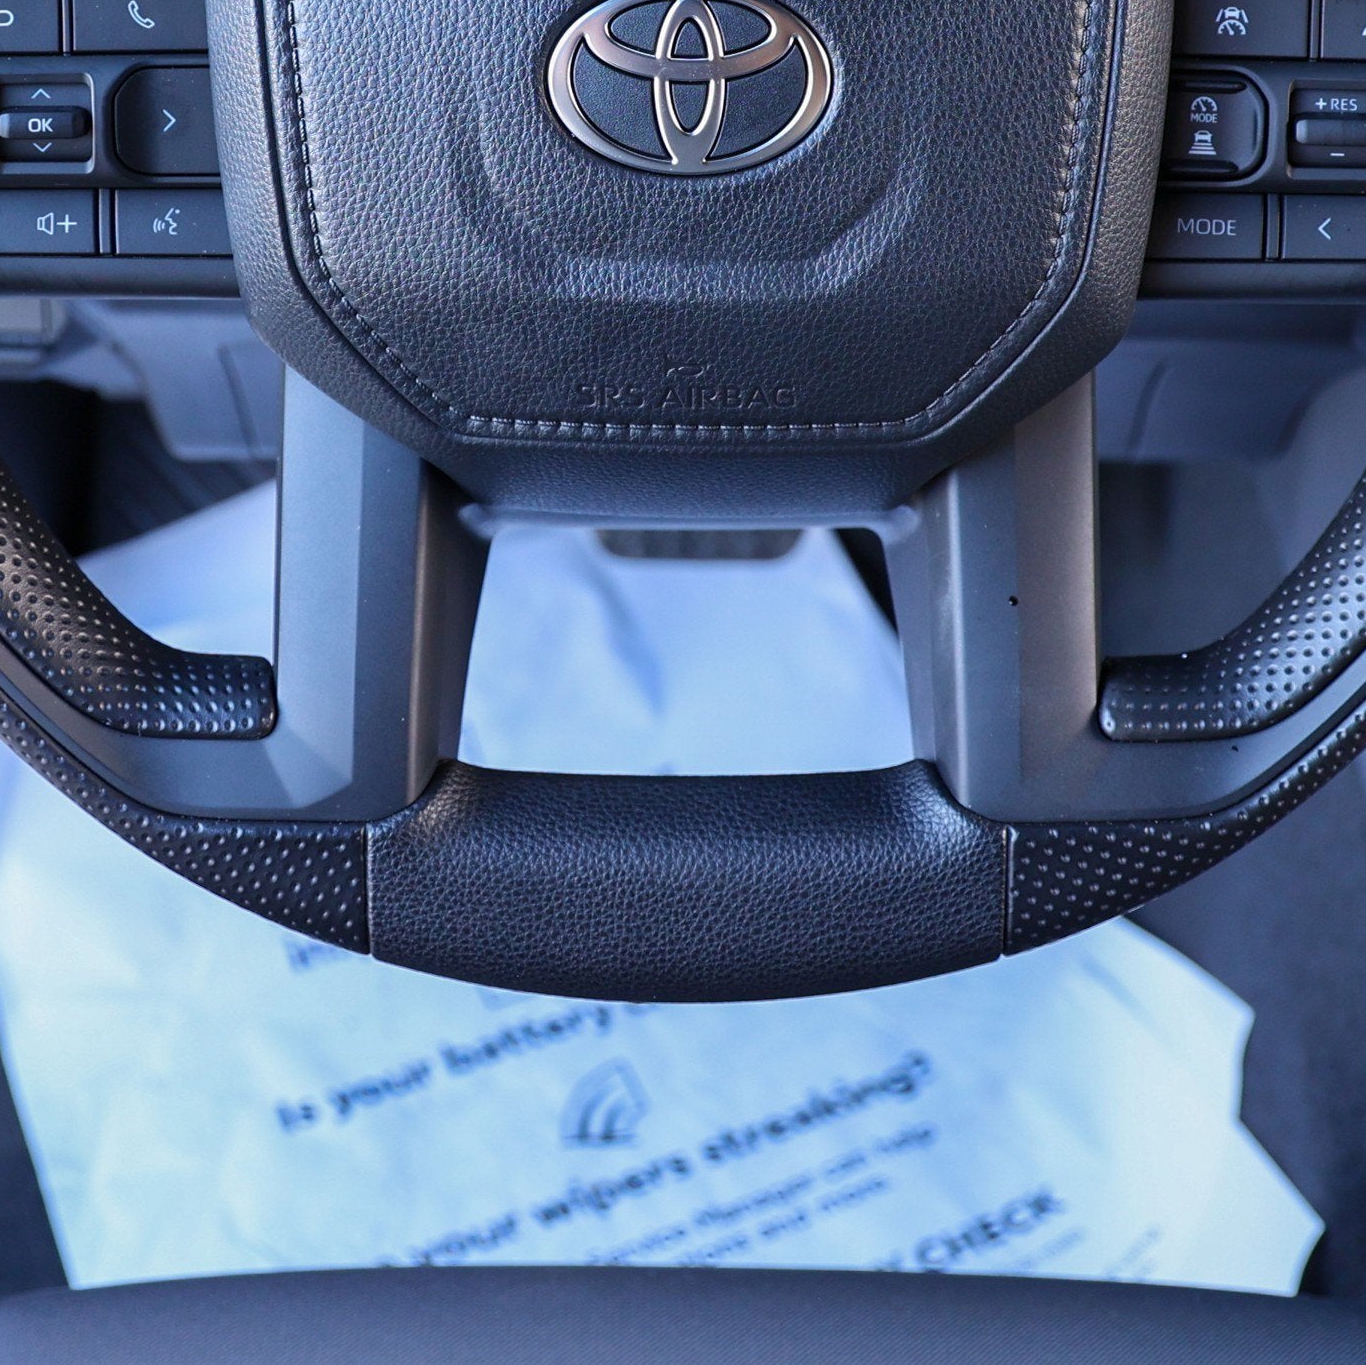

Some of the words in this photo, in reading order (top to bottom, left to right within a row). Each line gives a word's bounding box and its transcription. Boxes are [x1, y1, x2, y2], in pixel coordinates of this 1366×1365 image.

[28, 117, 54, 133] OK
[1190, 112, 1218, 124] MODE
[1177, 218, 1237, 236] MODE
[582, 386, 646, 409] SRS
[662, 386, 796, 410] AIRBAG
[275, 1098, 320, 1133] Is
[330, 1059, 431, 1122] your
[438, 1004, 613, 1078] battery
[534, 1153, 691, 1219] wipers
[701, 1047, 935, 1165] streaking?
[915, 1186, 1066, 1273] CHECK
